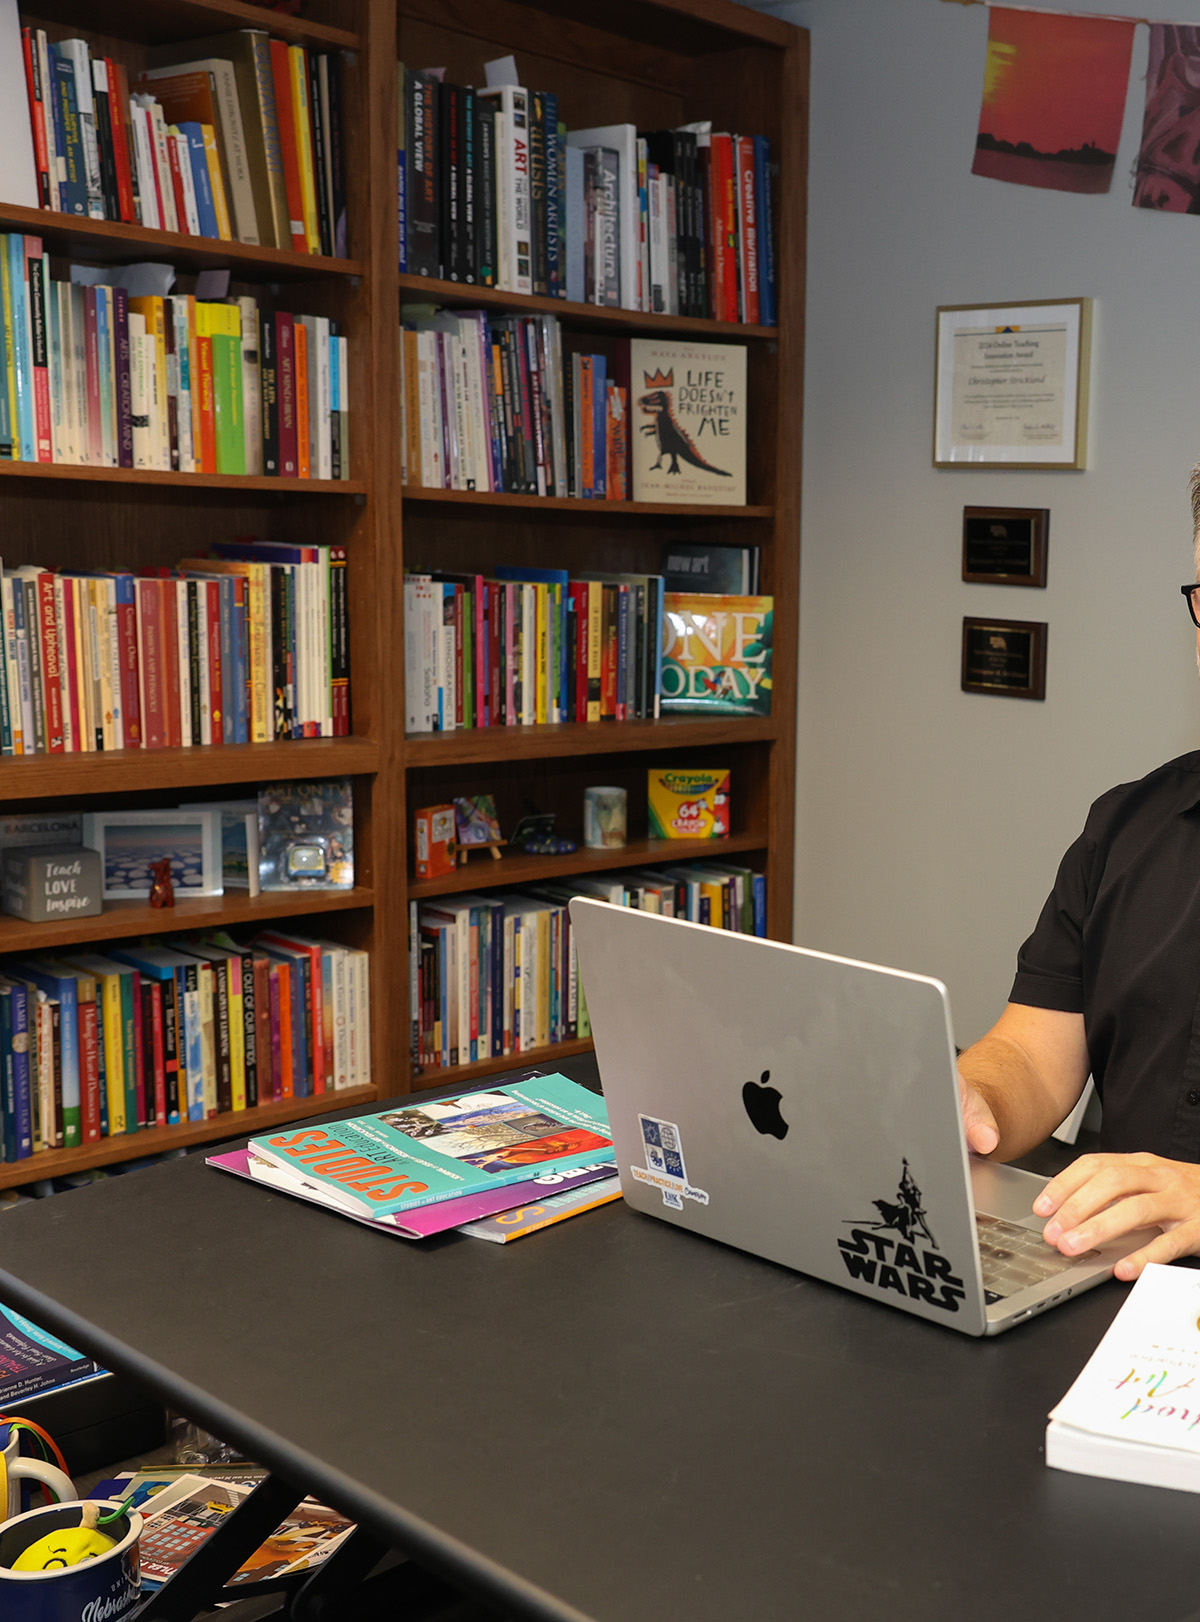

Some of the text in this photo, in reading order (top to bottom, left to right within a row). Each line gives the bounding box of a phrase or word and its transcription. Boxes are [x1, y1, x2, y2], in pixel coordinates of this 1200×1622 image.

[254, 44, 275, 116] GUSTAV
[414, 81, 424, 172] A GLOBAL VIEW
[424, 84, 433, 202] THE HISTORY OF ART
[233, 144, 240, 154] AT
[514, 139, 528, 174] ART
[532, 126, 545, 200] artists
[546, 134, 558, 196] WOMEN
[234, 156, 244, 182] WORK
[516, 197, 524, 230] WORLD
[548, 200, 558, 262] ARTISTS
[603, 170, 617, 278] Architecture
[744, 170, 758, 292] Creative Illustration
[120, 338, 132, 450] ARTS CREATION MIND
[202, 372, 210, 412] Thinking
[678, 386, 734, 404] DOESN'T
[686, 370, 724, 388] LIFE
[678, 402, 738, 418] FRIGHTEN
[698, 417, 730, 436] ME
[43, 582, 60, 678] Art and Upheaval
[124, 607, 135, 636] Creating
[444, 631, 452, 711] ETHNOGRAPHIC
[607, 625, 616, 696] Relational Being
[148, 674, 157, 713] PEDAGOGY
[265, 784, 352, 798] ART ON TV
[665, 772, 712, 784] Crayola
[4, 821, 78, 834] BARCELONA
[678, 804, 699, 818] 64
[46, 861, 80, 876] Teach
[46, 882, 76, 895] LOVE
[46, 896, 90, 912] Inspire
[336, 960, 344, 986] Adam
[16, 993, 26, 1030] PALMER
[218, 967, 229, 1056] LANDSCAPES OF LEARNING
[244, 973, 255, 1033] OUT OF OUR
[83, 1008, 96, 1038] Healing
[166, 1009, 175, 1052] Blue Guitar
[88, 1050, 96, 1072] Heart
[337, 1028, 346, 1069] Originals
[327, 1123, 400, 1164] ART Education
[267, 1130, 429, 1202] STUDIES
[400, 1200, 421, 1210] STUDIES
[436, 1190, 463, 1202] EDUCATION
[837, 1228, 964, 1288] STAR
[839, 1250, 966, 1312] WARS
[70, 1364, 90, 1373] Routledge
[1110, 1368, 1196, 1398] Art
[10, 1385, 34, 1397] Beverley
